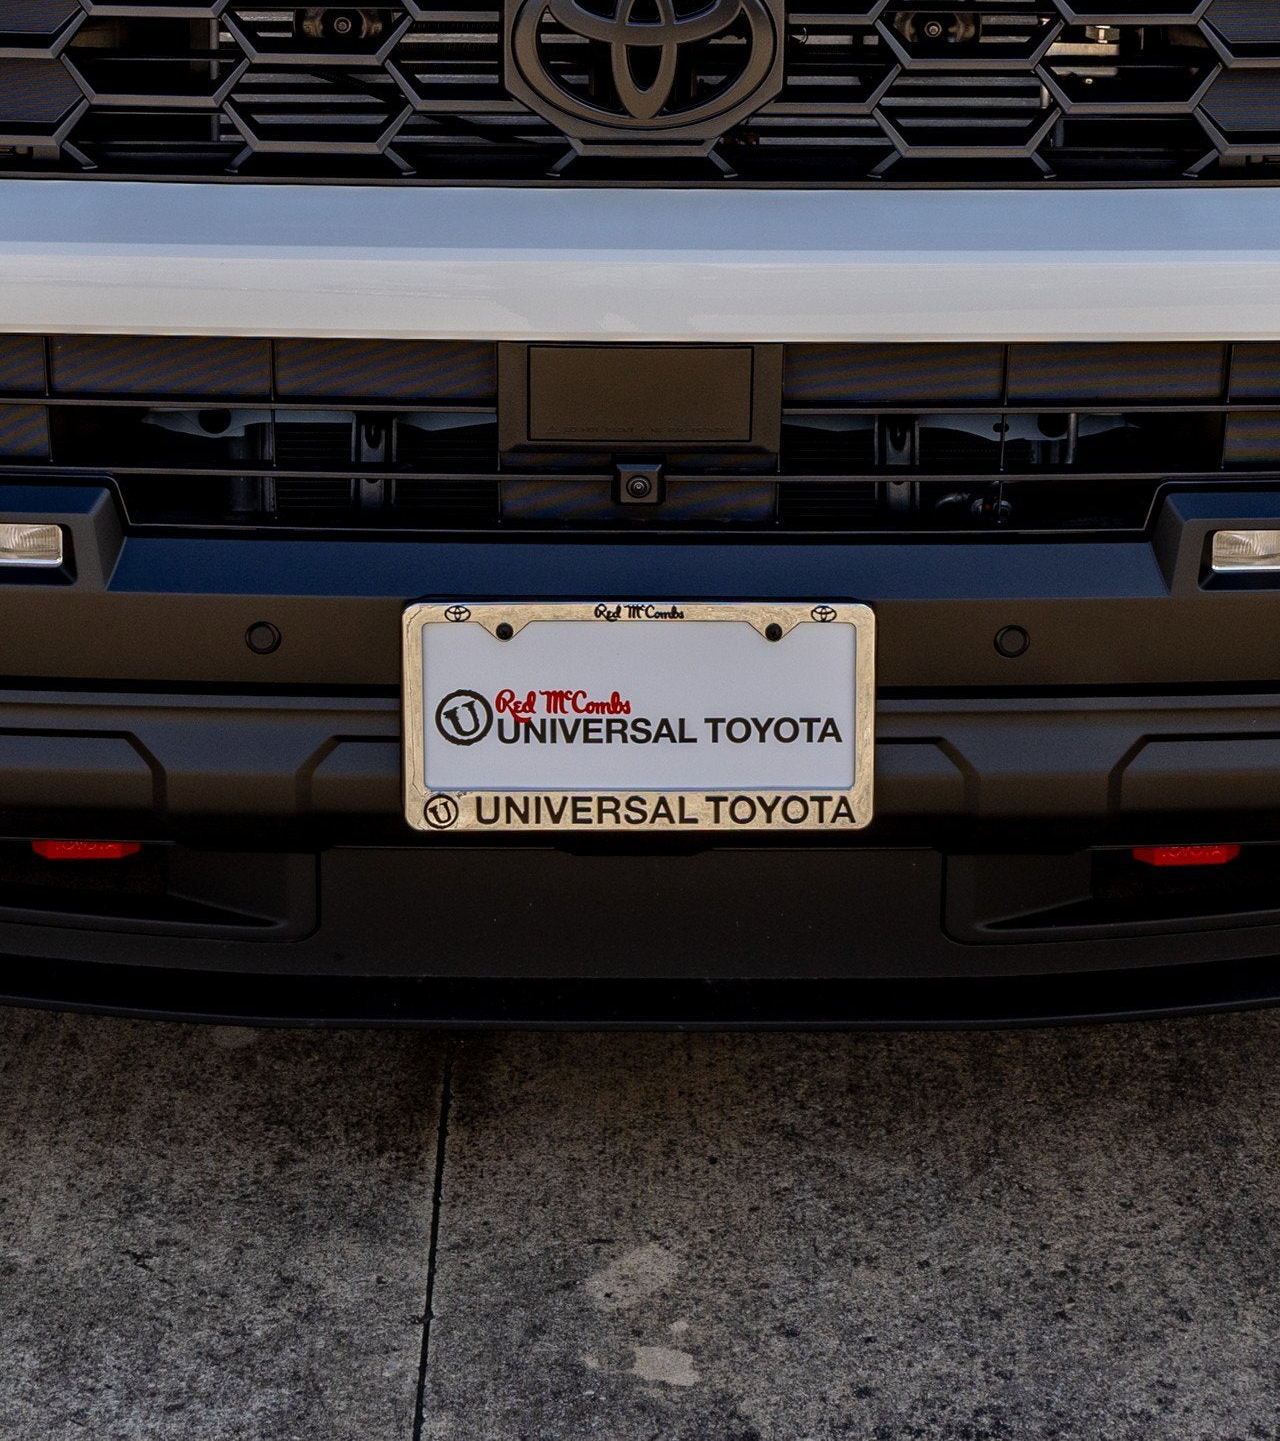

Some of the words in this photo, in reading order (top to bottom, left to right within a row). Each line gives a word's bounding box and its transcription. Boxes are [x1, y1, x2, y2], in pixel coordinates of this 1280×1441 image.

[594, 603, 621, 622] Red
[627, 603, 685, 620] McCombs
[495, 688, 536, 724] Red
[539, 690, 631, 715] McCombs
[496, 717, 698, 745] UNIVERSAL
[704, 716, 843, 744] TOYOTA
[475, 795, 699, 825] UNIVERSAL
[705, 795, 856, 825] TOYOTA
